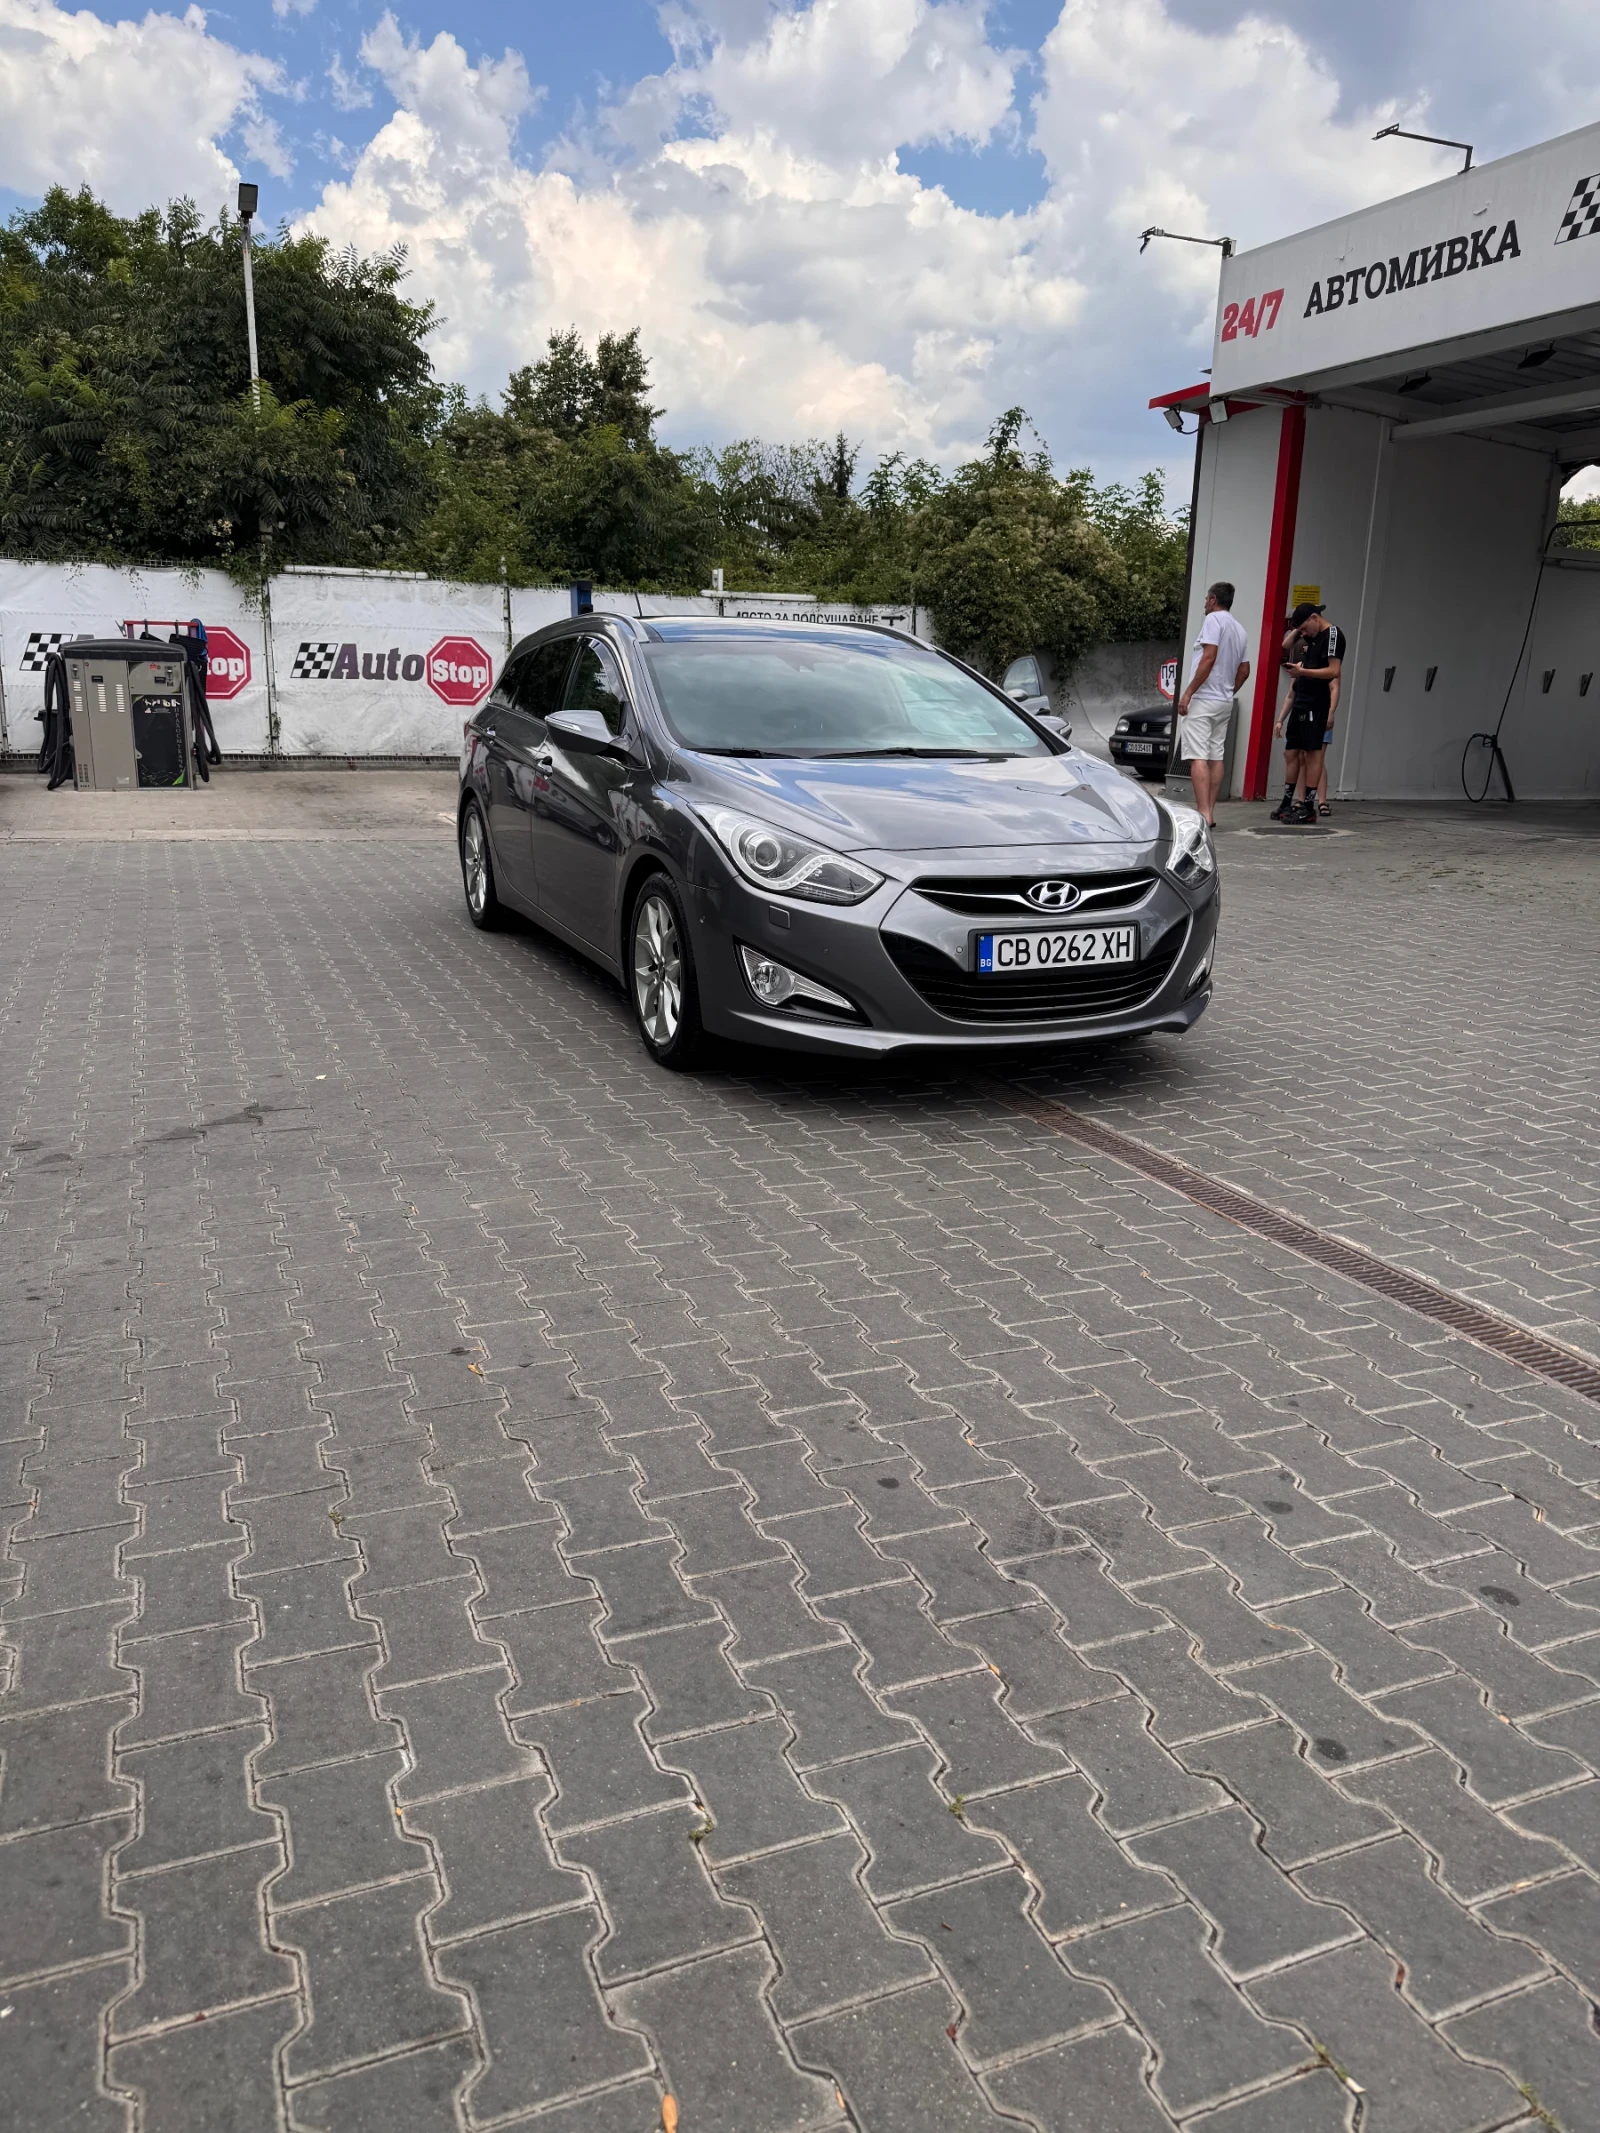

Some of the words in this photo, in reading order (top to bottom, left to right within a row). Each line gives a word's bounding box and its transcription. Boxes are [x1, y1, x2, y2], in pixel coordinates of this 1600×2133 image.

[1221, 288, 1285, 342] 24/7
[1303, 220, 1521, 318] АВТОМИВКА
[207, 657, 244, 682] op
[331, 643, 426, 682] Auto
[432, 659, 487, 689] Stop
[1162, 665, 1175, 679] ПЯ
[980, 958, 992, 968] BG
[997, 938, 1031, 967] CB
[1036, 933, 1096, 964] 0262
[1101, 930, 1131, 960] XH
